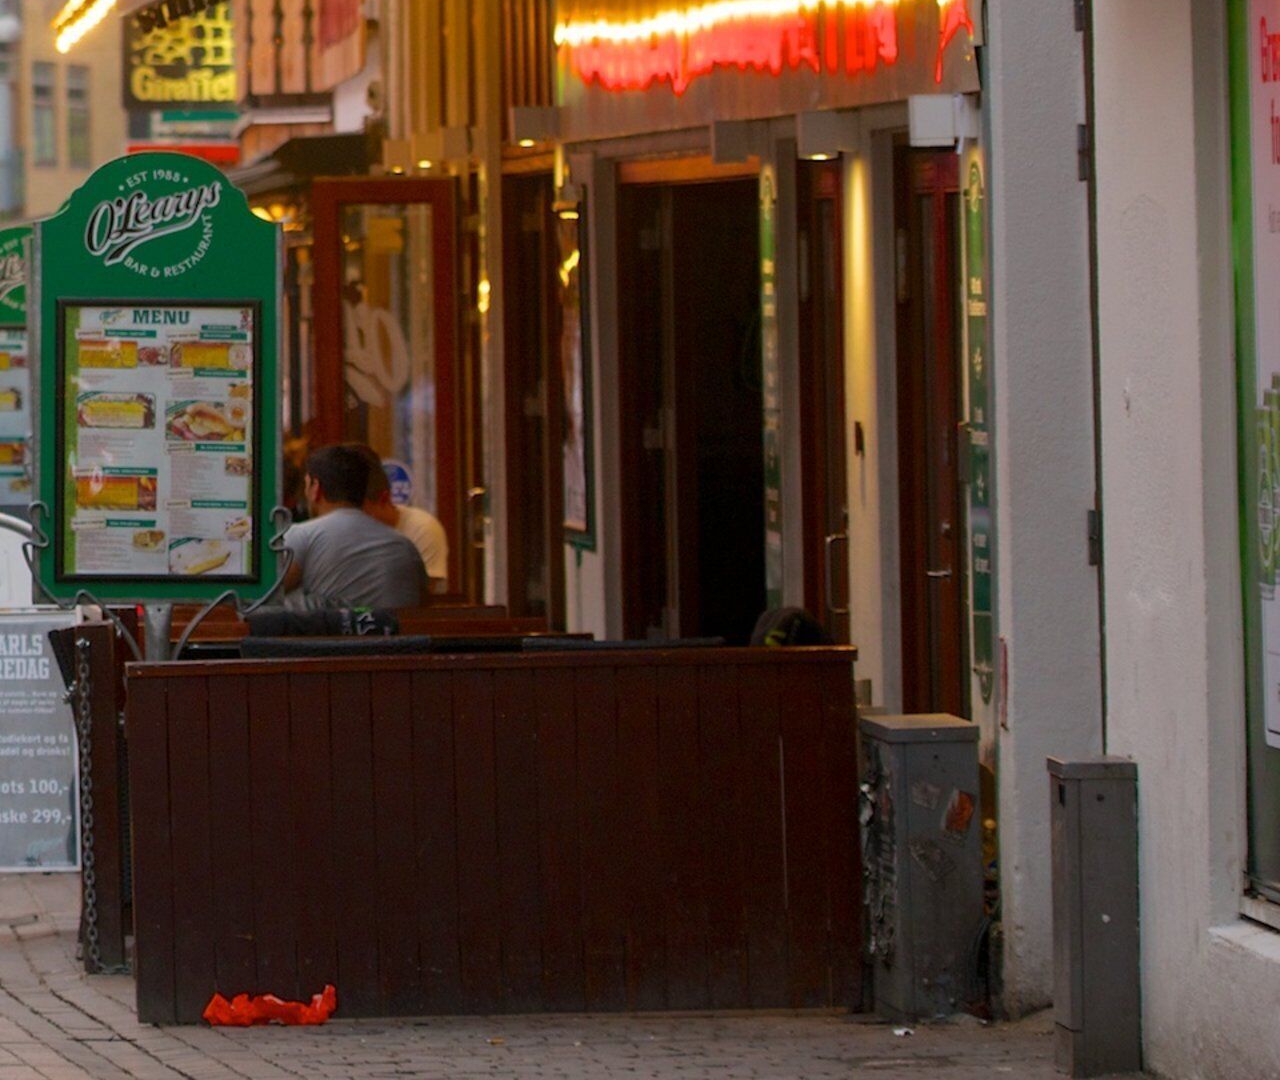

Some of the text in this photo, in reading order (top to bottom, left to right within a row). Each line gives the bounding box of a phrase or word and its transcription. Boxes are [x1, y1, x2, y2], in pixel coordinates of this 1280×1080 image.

[127, 169, 181, 188] EST 1988
[85, 181, 222, 266] O'Learys
[123, 256, 147, 275] BAR
[164, 214, 212, 277] RESTAURANT
[133, 309, 190, 324] MENU
[29, 779, 69, 796] 100,-
[31, 809, 72, 825] 299,-
